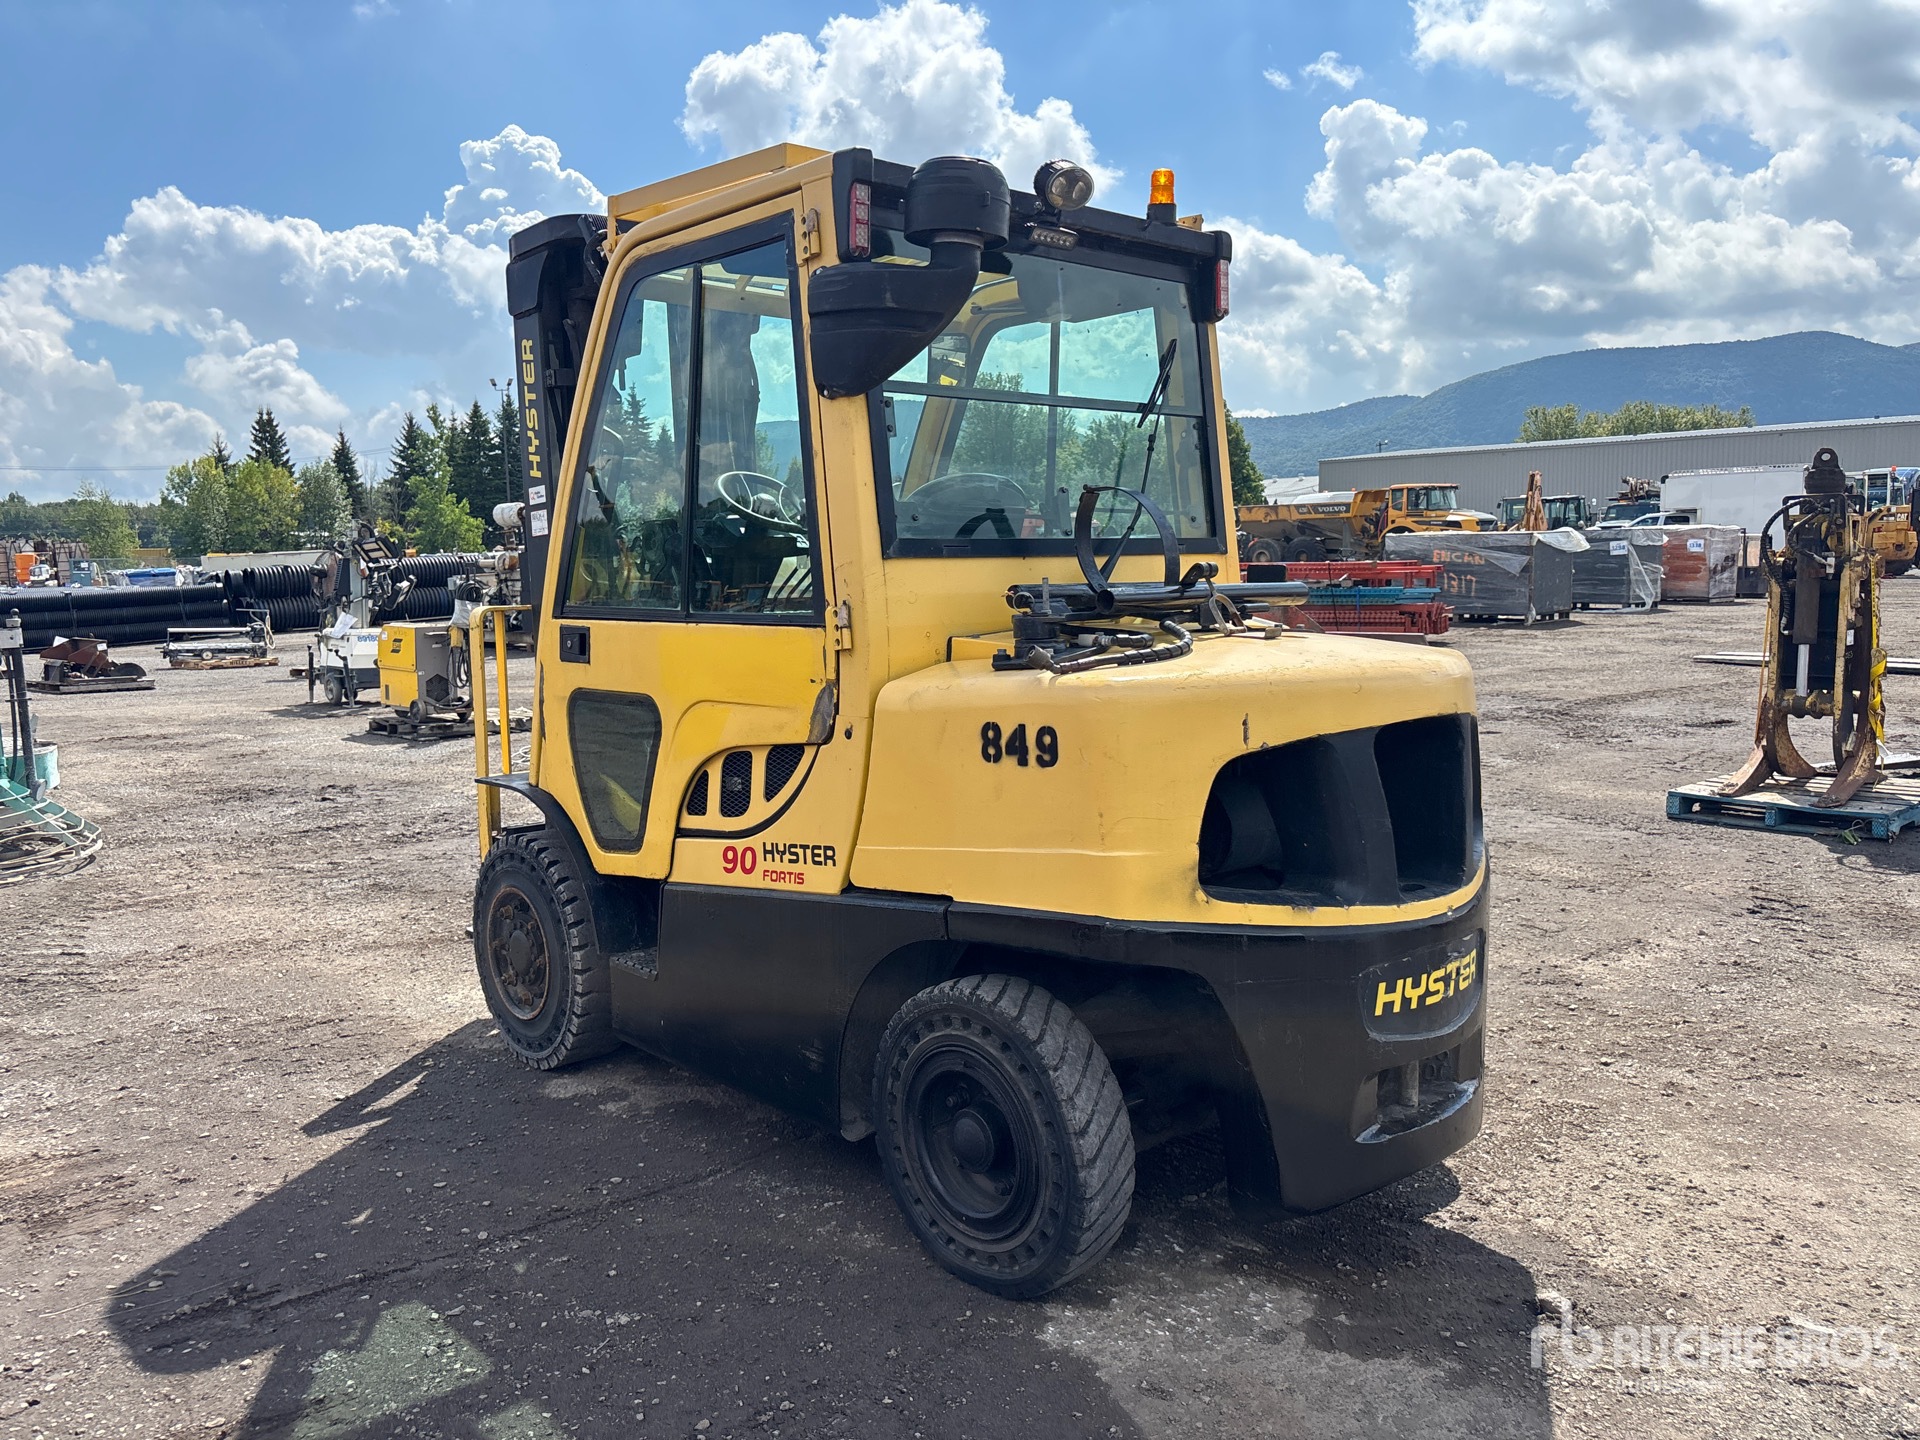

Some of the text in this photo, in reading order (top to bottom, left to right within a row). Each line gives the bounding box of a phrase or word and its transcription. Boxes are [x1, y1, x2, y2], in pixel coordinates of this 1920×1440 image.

[521, 338, 542, 478] HYSTER
[1896, 513, 1909, 522] CAT
[1433, 549, 1485, 565] ENCAN
[981, 721, 1058, 768] 849
[722, 842, 837, 875] 90 HYSTER
[762, 869, 805, 885] FORTIS
[1374, 948, 1477, 1017] HYSTER
